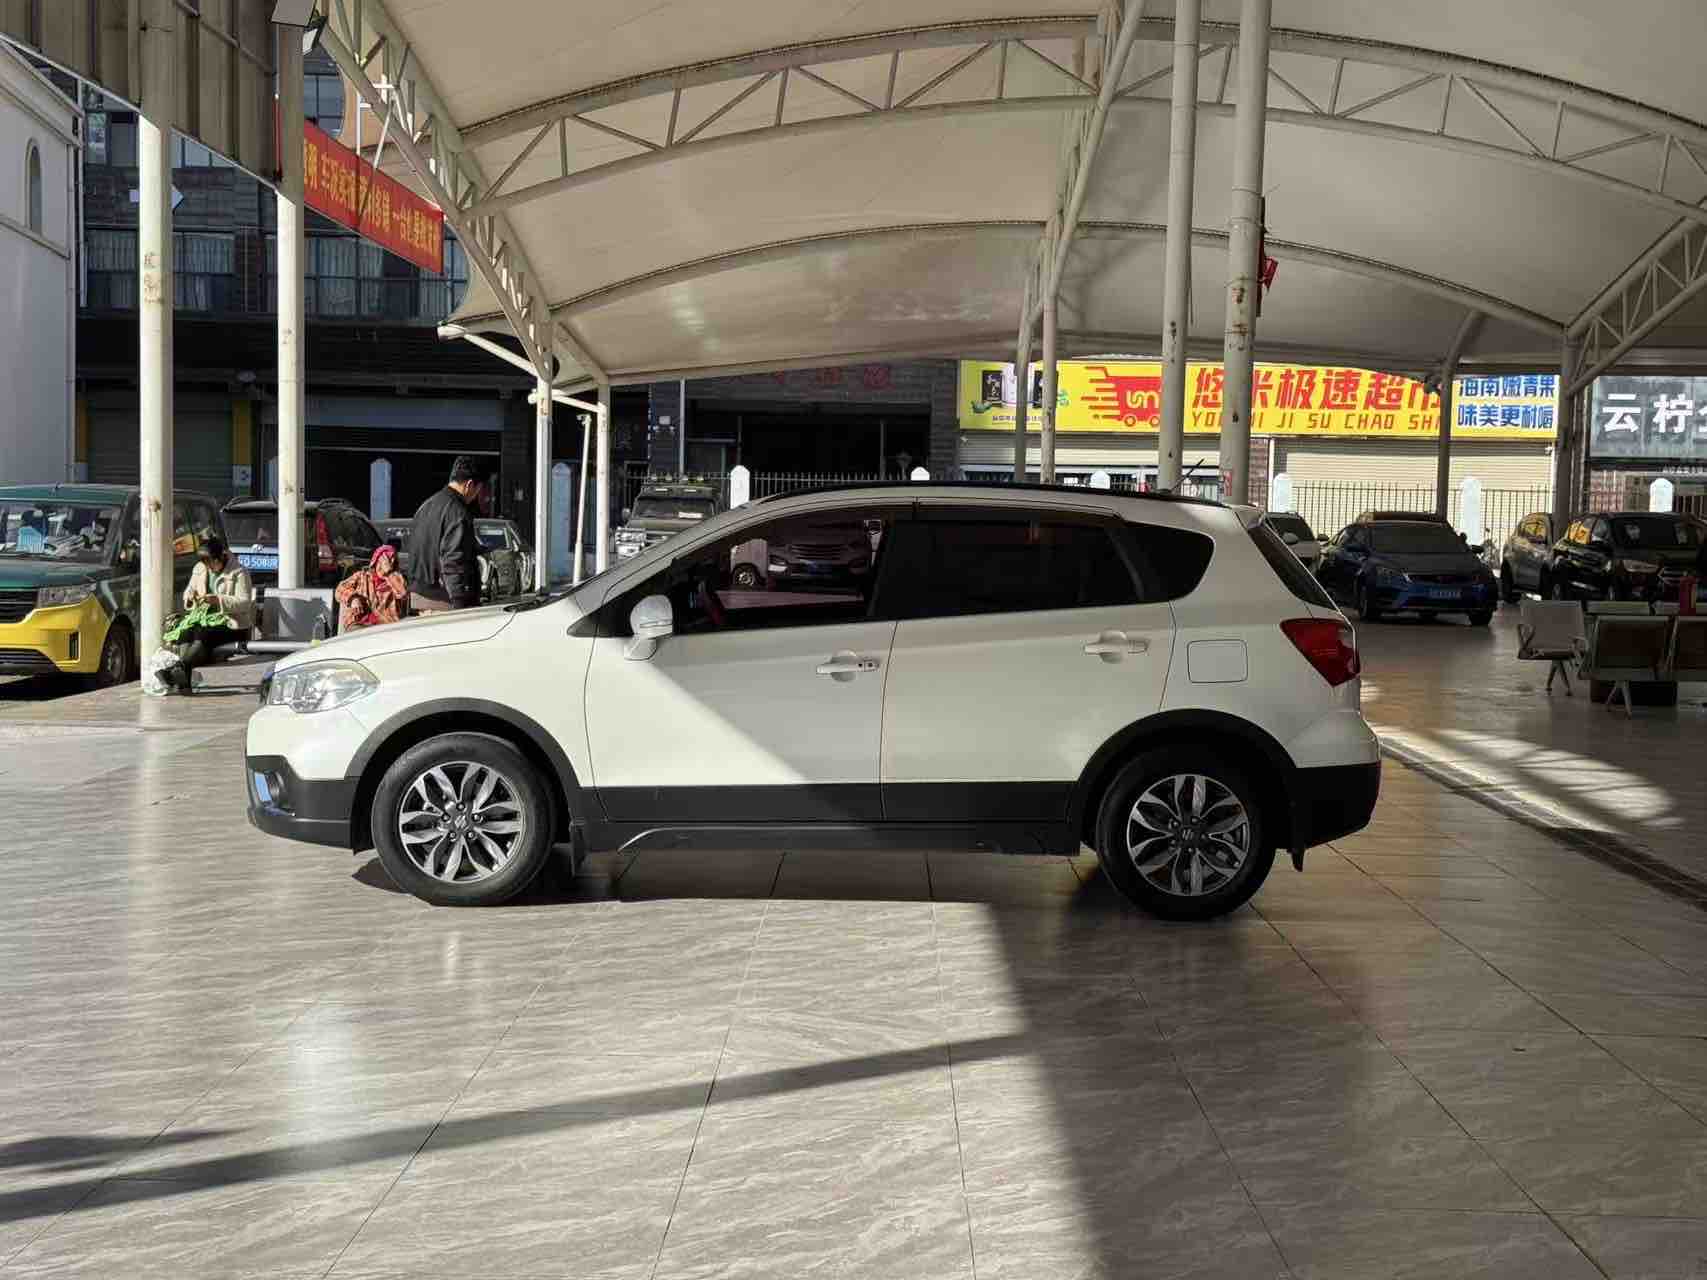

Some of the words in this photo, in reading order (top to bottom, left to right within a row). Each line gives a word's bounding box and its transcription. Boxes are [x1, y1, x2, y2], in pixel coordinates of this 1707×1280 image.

[1273, 412, 1294, 429] JI
[1307, 412, 1331, 429] SU
[1344, 413, 1394, 430] CHAO
